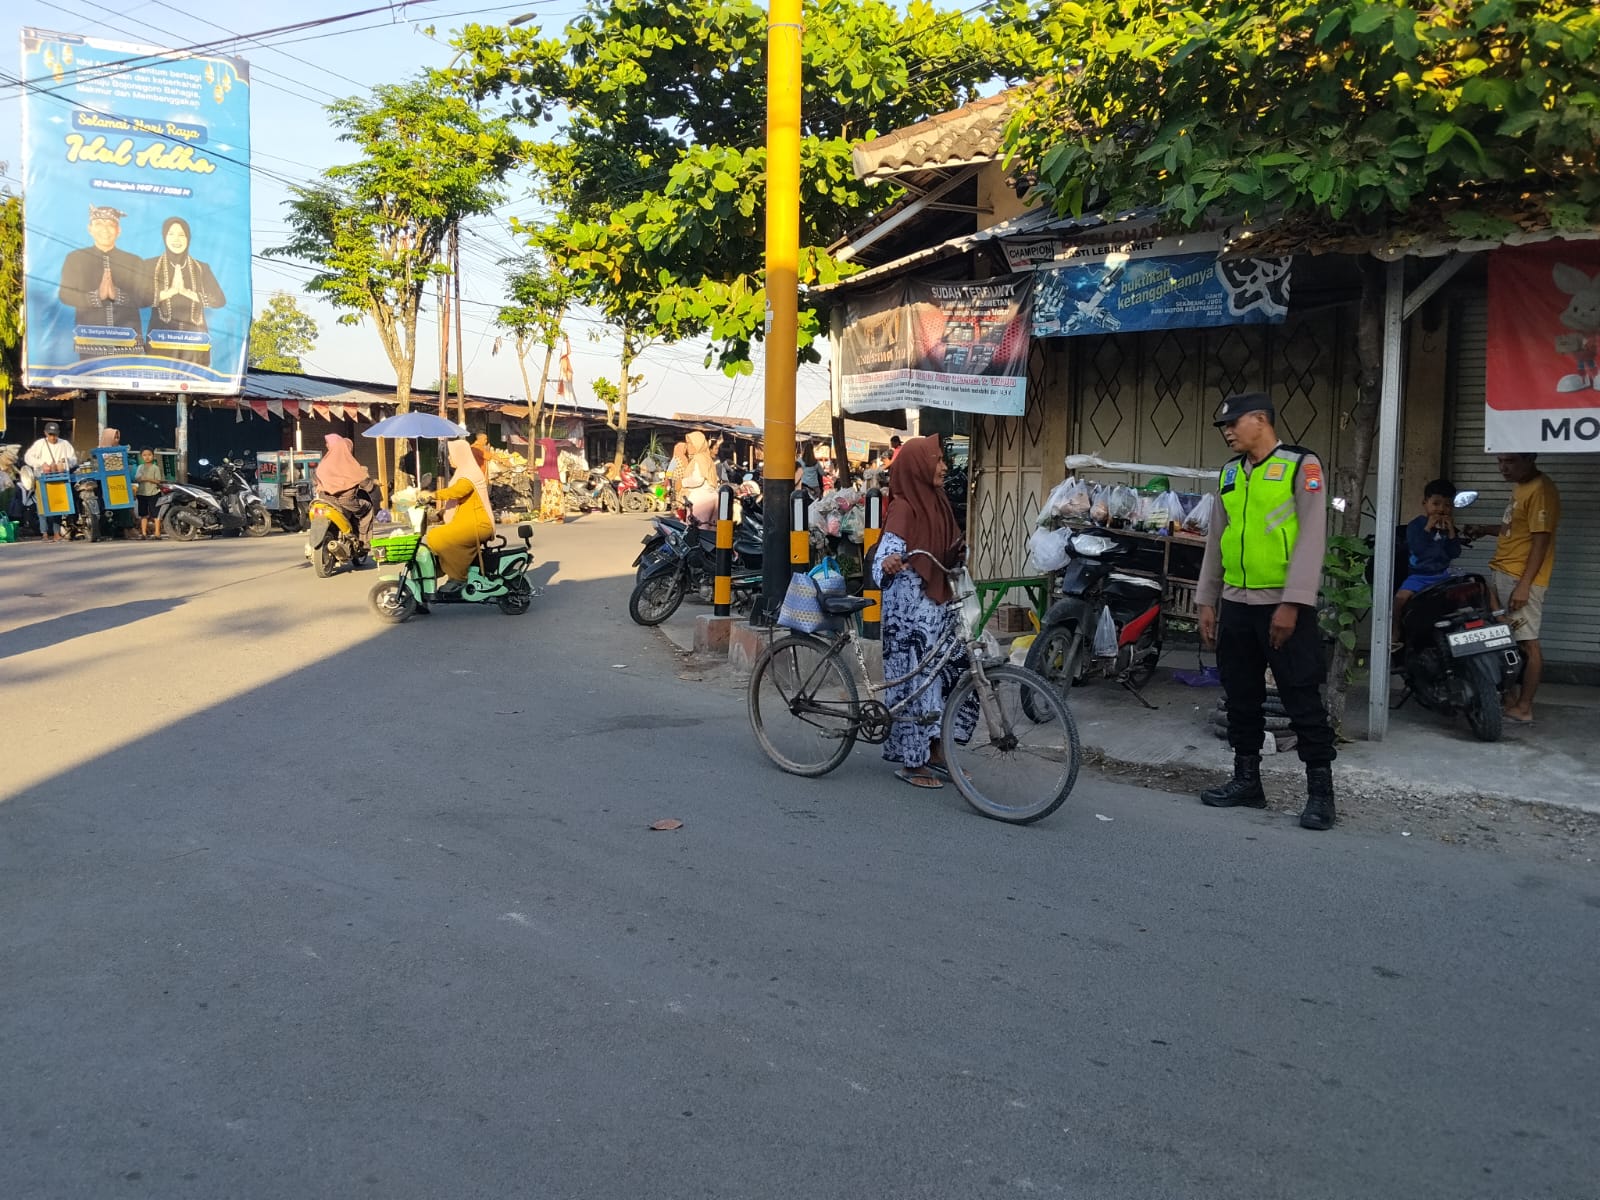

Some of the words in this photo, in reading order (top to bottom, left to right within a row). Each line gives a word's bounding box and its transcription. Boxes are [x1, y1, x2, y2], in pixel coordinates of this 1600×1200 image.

[78, 113, 131, 130] Selamat
[132, 118, 165, 134] Hari
[166, 123, 200, 141] Raya
[65, 134, 133, 166] Idul
[136, 142, 217, 173] Adha
[1009, 245, 1051, 259] CHAMPION
[1064, 249, 1090, 259] PASTI
[1092, 245, 1121, 256] LEBIH
[1124, 241, 1154, 253] AWET
[931, 286, 962, 299] SUDAH
[962, 284, 1015, 299] TERBUKTI
[1118, 268, 1214, 310] ketangguhannya
[1121, 268, 1170, 294] buktikan
[1541, 416, 1600, 441] MO
